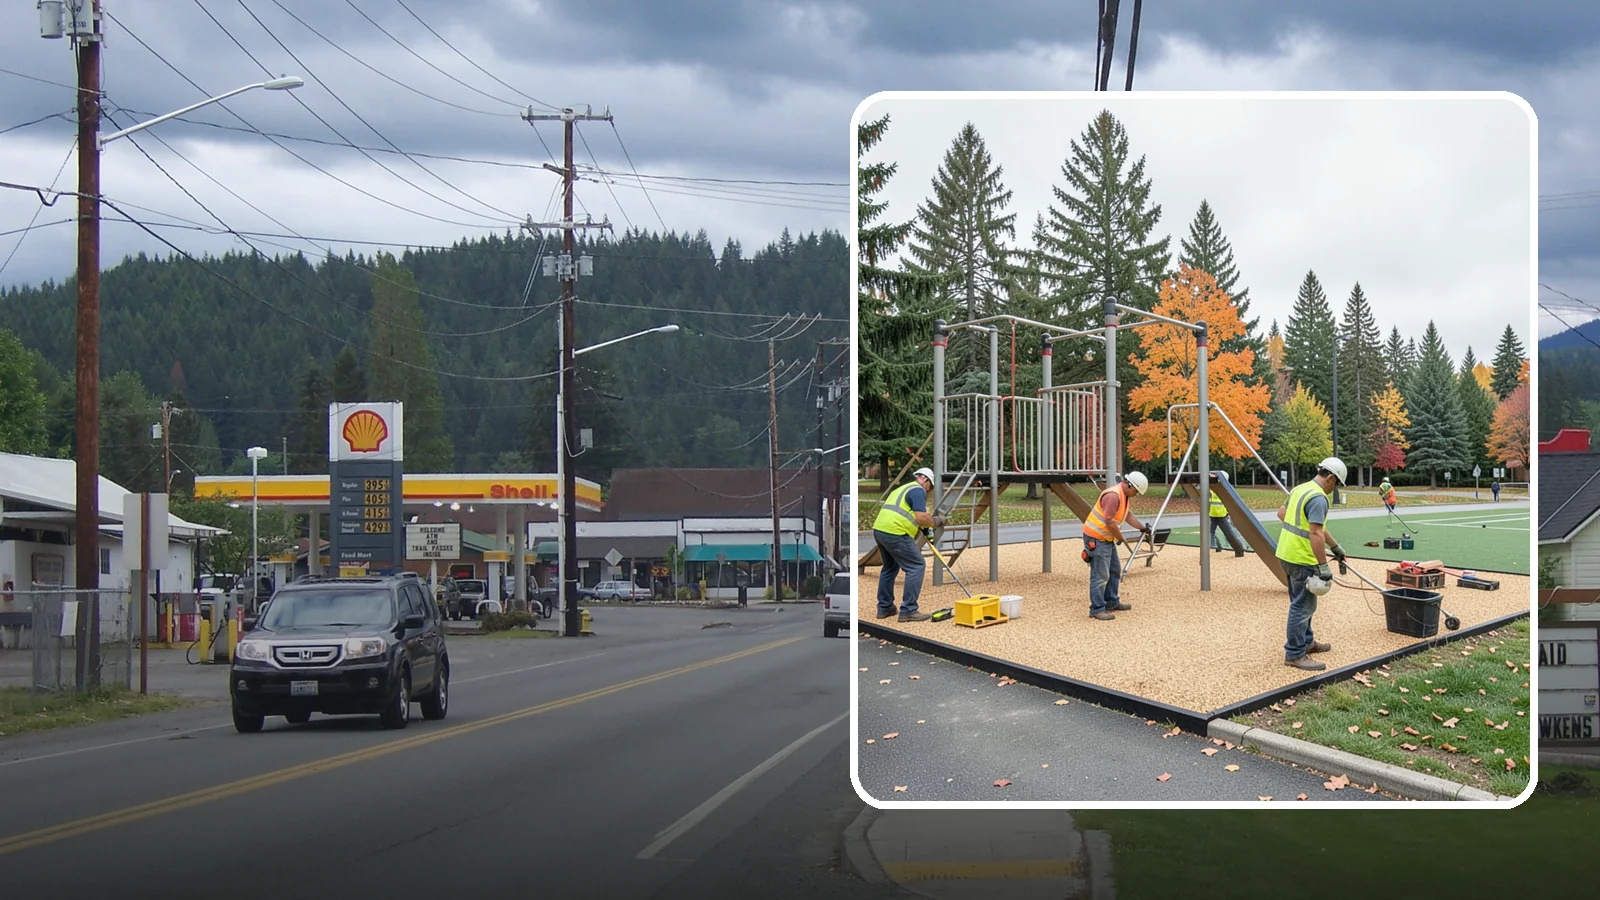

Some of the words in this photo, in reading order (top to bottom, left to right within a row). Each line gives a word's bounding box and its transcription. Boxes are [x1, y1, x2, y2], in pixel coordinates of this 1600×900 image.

[366, 480, 383, 490] 395
[490, 484, 547, 499] Shell
[366, 494, 383, 504] 405
[366, 508, 383, 518] 415
[366, 522, 383, 532] 429
[1540, 643, 1566, 665] AID
